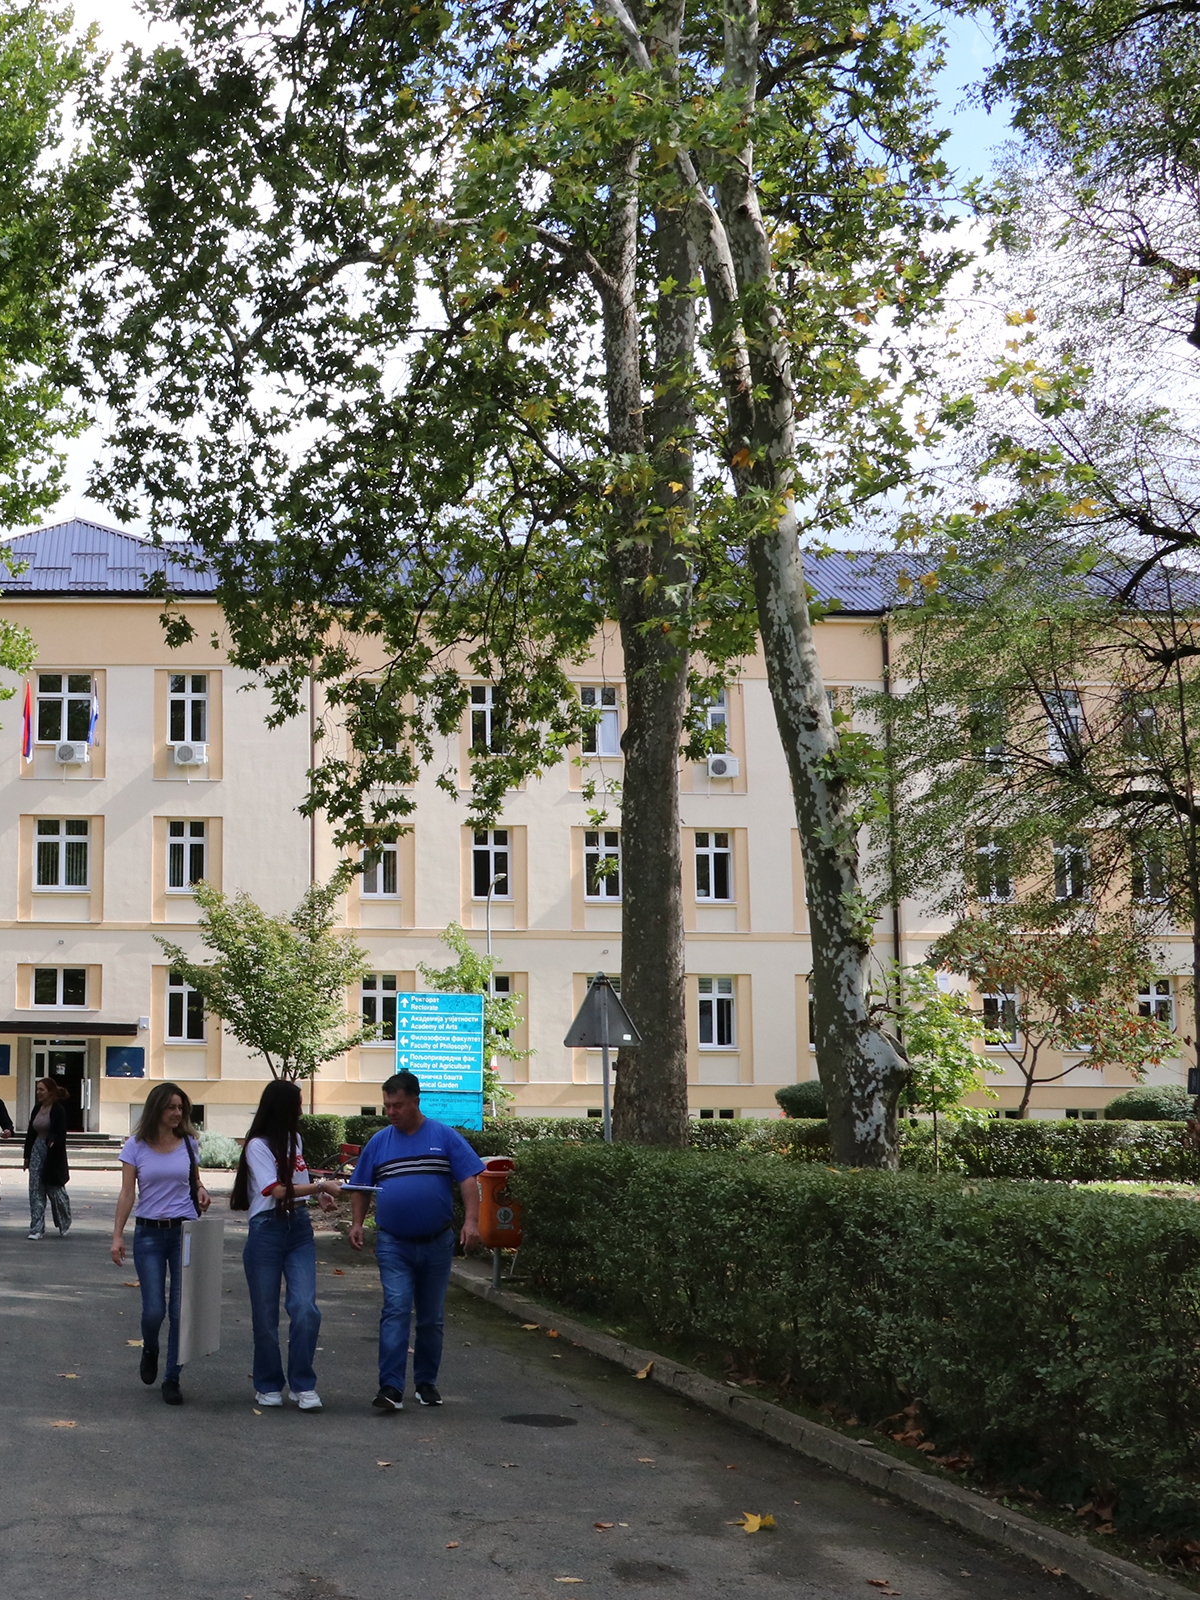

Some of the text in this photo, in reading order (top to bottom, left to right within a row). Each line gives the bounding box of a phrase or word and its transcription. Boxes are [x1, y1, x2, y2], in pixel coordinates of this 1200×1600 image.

[411, 1015, 443, 1023] Академија
[411, 1023, 437, 1031] Academy
[410, 1034, 450, 1042] Филозофски
[410, 1042, 431, 1050] Faculty
[440, 1043, 472, 1051] Philosophy
[410, 1061, 431, 1069] Faculty
